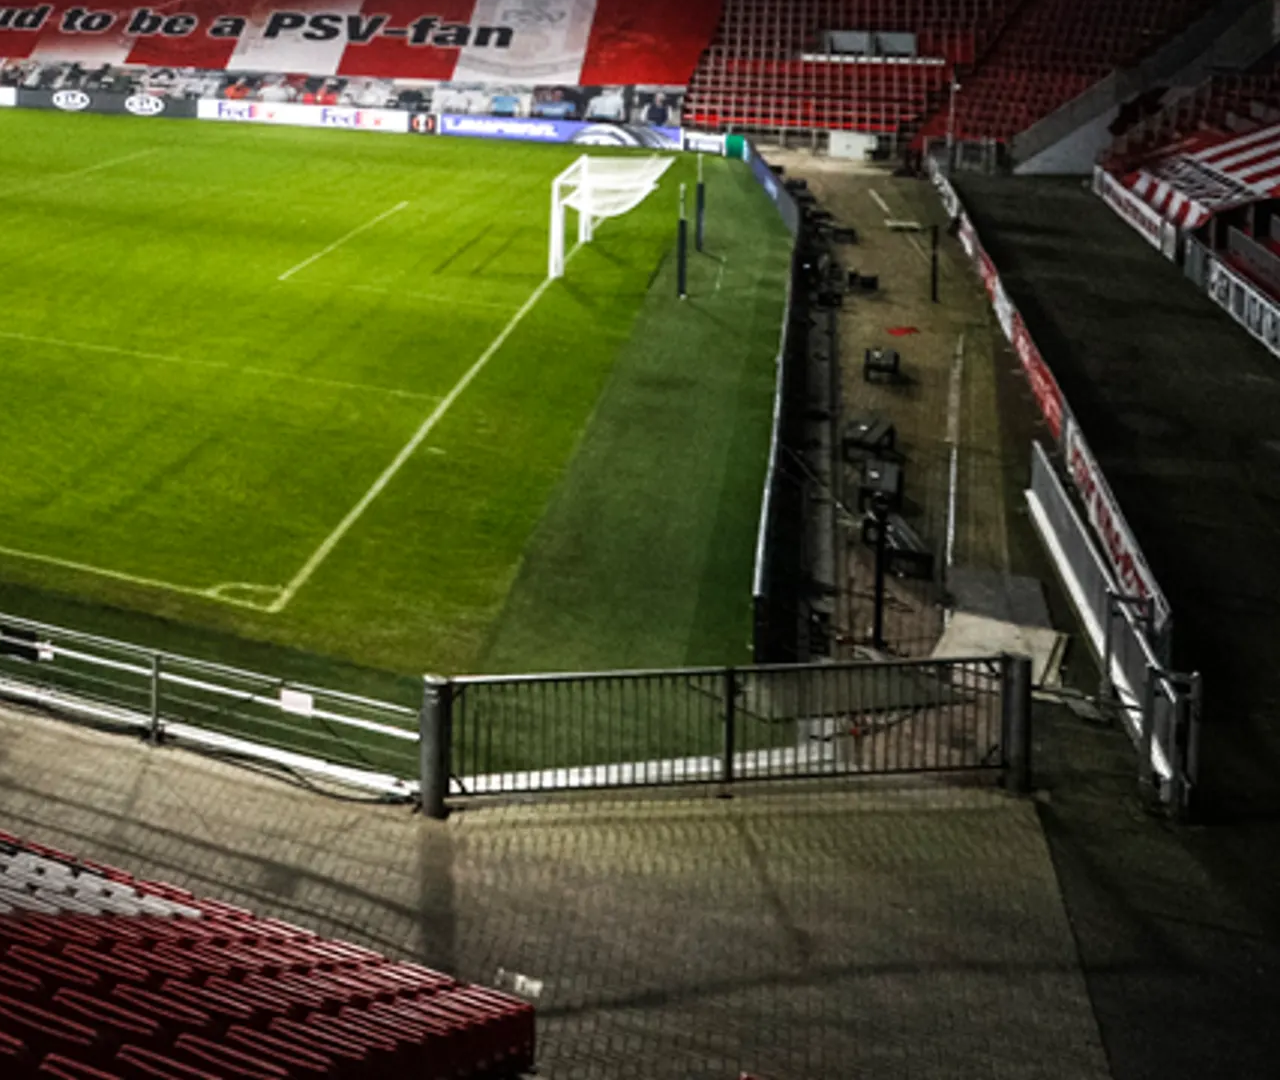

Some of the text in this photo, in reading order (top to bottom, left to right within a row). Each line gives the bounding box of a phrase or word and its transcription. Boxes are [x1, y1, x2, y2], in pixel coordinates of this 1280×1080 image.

[60, 5, 116, 35] to
[125, 7, 198, 38] be
[207, 15, 246, 40] a
[262, 11, 516, 49] PSV-fan
